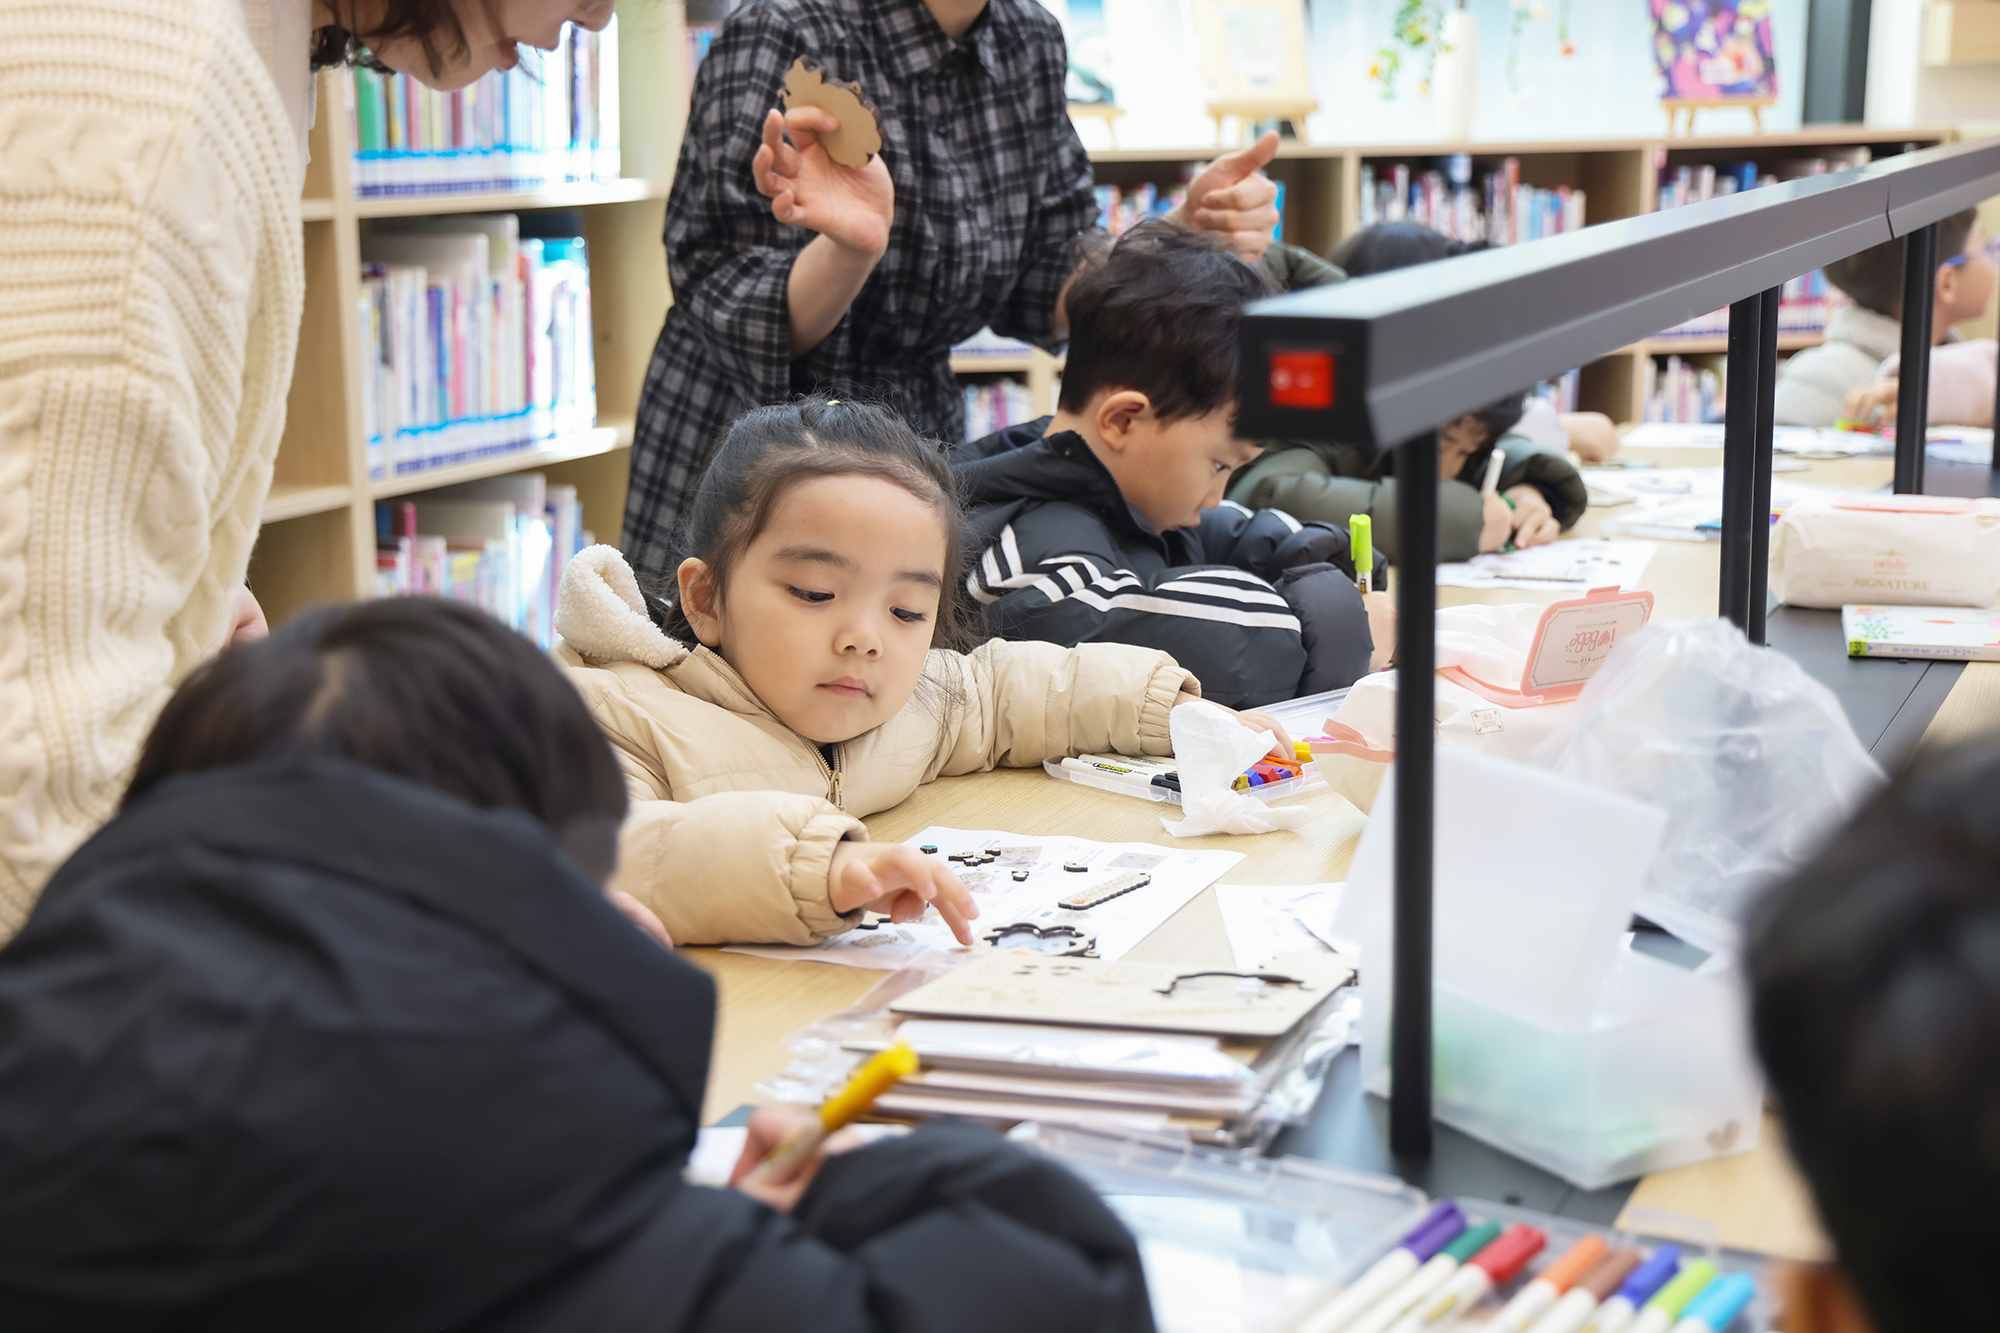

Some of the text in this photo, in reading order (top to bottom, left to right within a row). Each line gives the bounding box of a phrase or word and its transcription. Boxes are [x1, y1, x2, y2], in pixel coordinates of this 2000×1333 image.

[1853, 577, 1931, 591] SIGNATURE
[1585, 604, 1617, 614] SIGNATURE
[1480, 720, 1497, 729] SIZE
